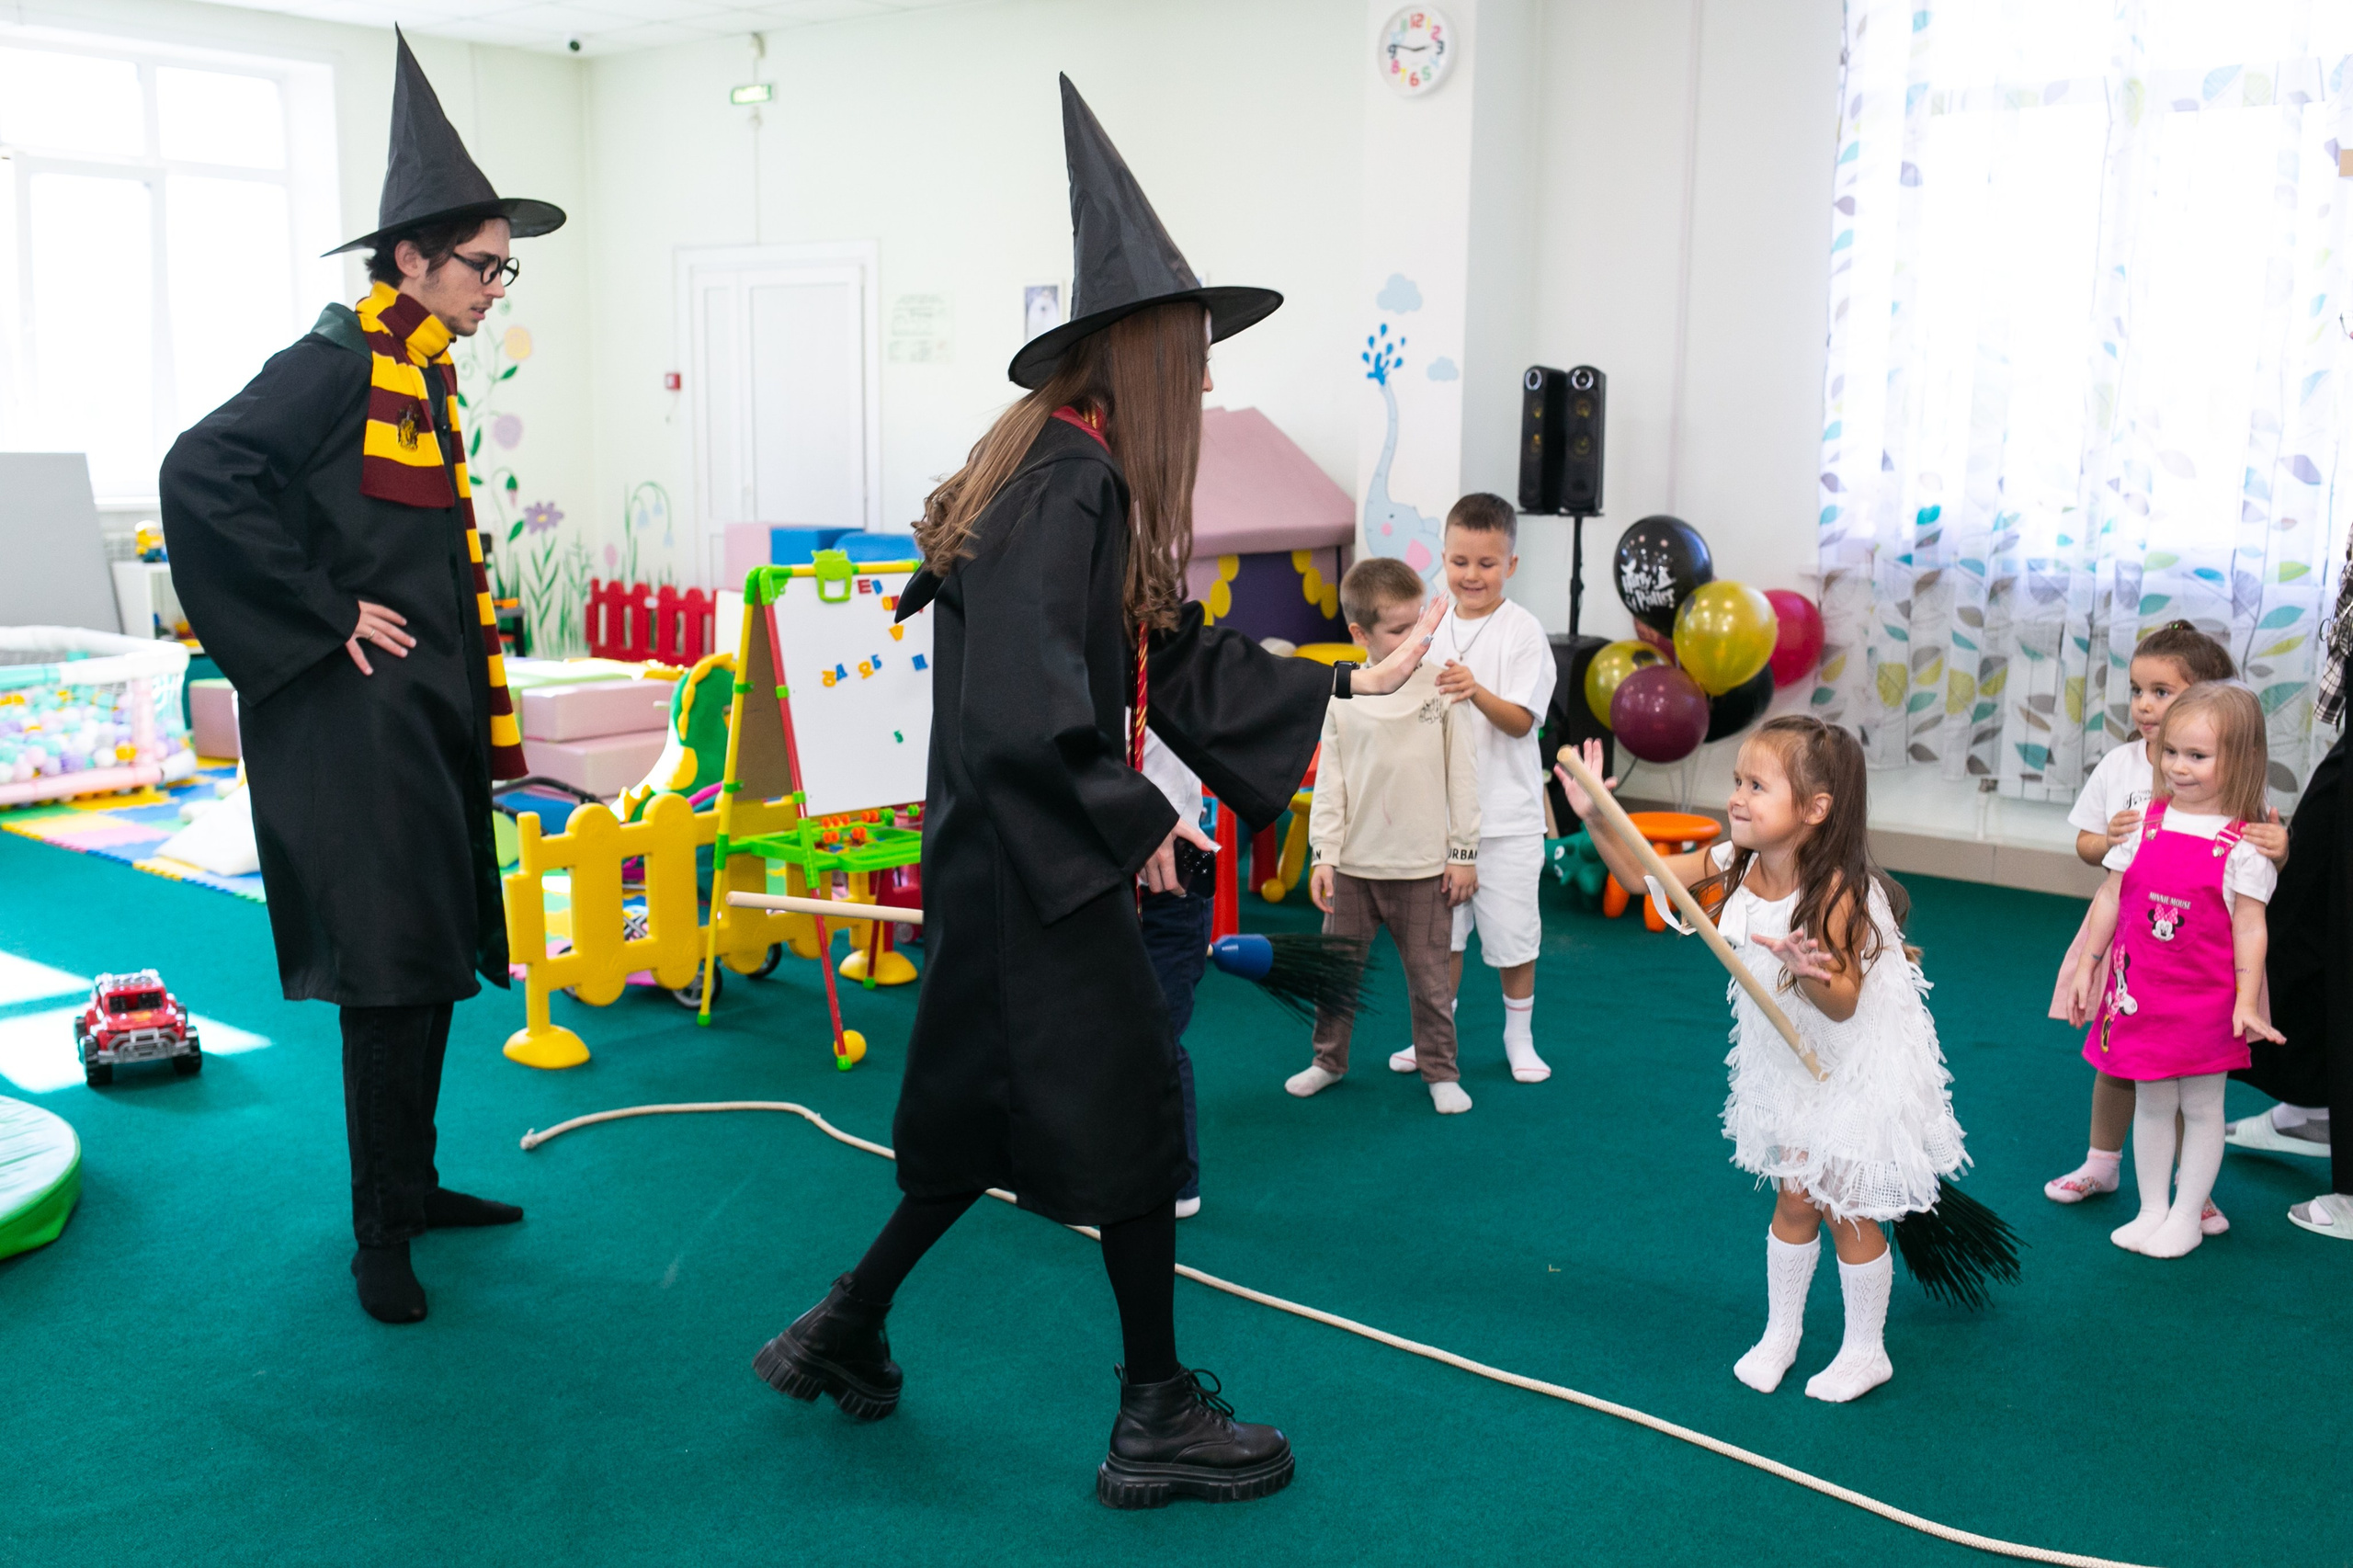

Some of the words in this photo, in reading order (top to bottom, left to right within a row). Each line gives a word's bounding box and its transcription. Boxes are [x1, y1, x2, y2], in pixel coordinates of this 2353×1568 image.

[1431, 25, 1441, 40] 2
[1388, 44, 1397, 59] 9
[1437, 40, 1444, 55] 3
[1409, 72, 1419, 86] 6
[2149, 892, 2169, 905] MINNIE
[2170, 897, 2191, 910] MOUSE
